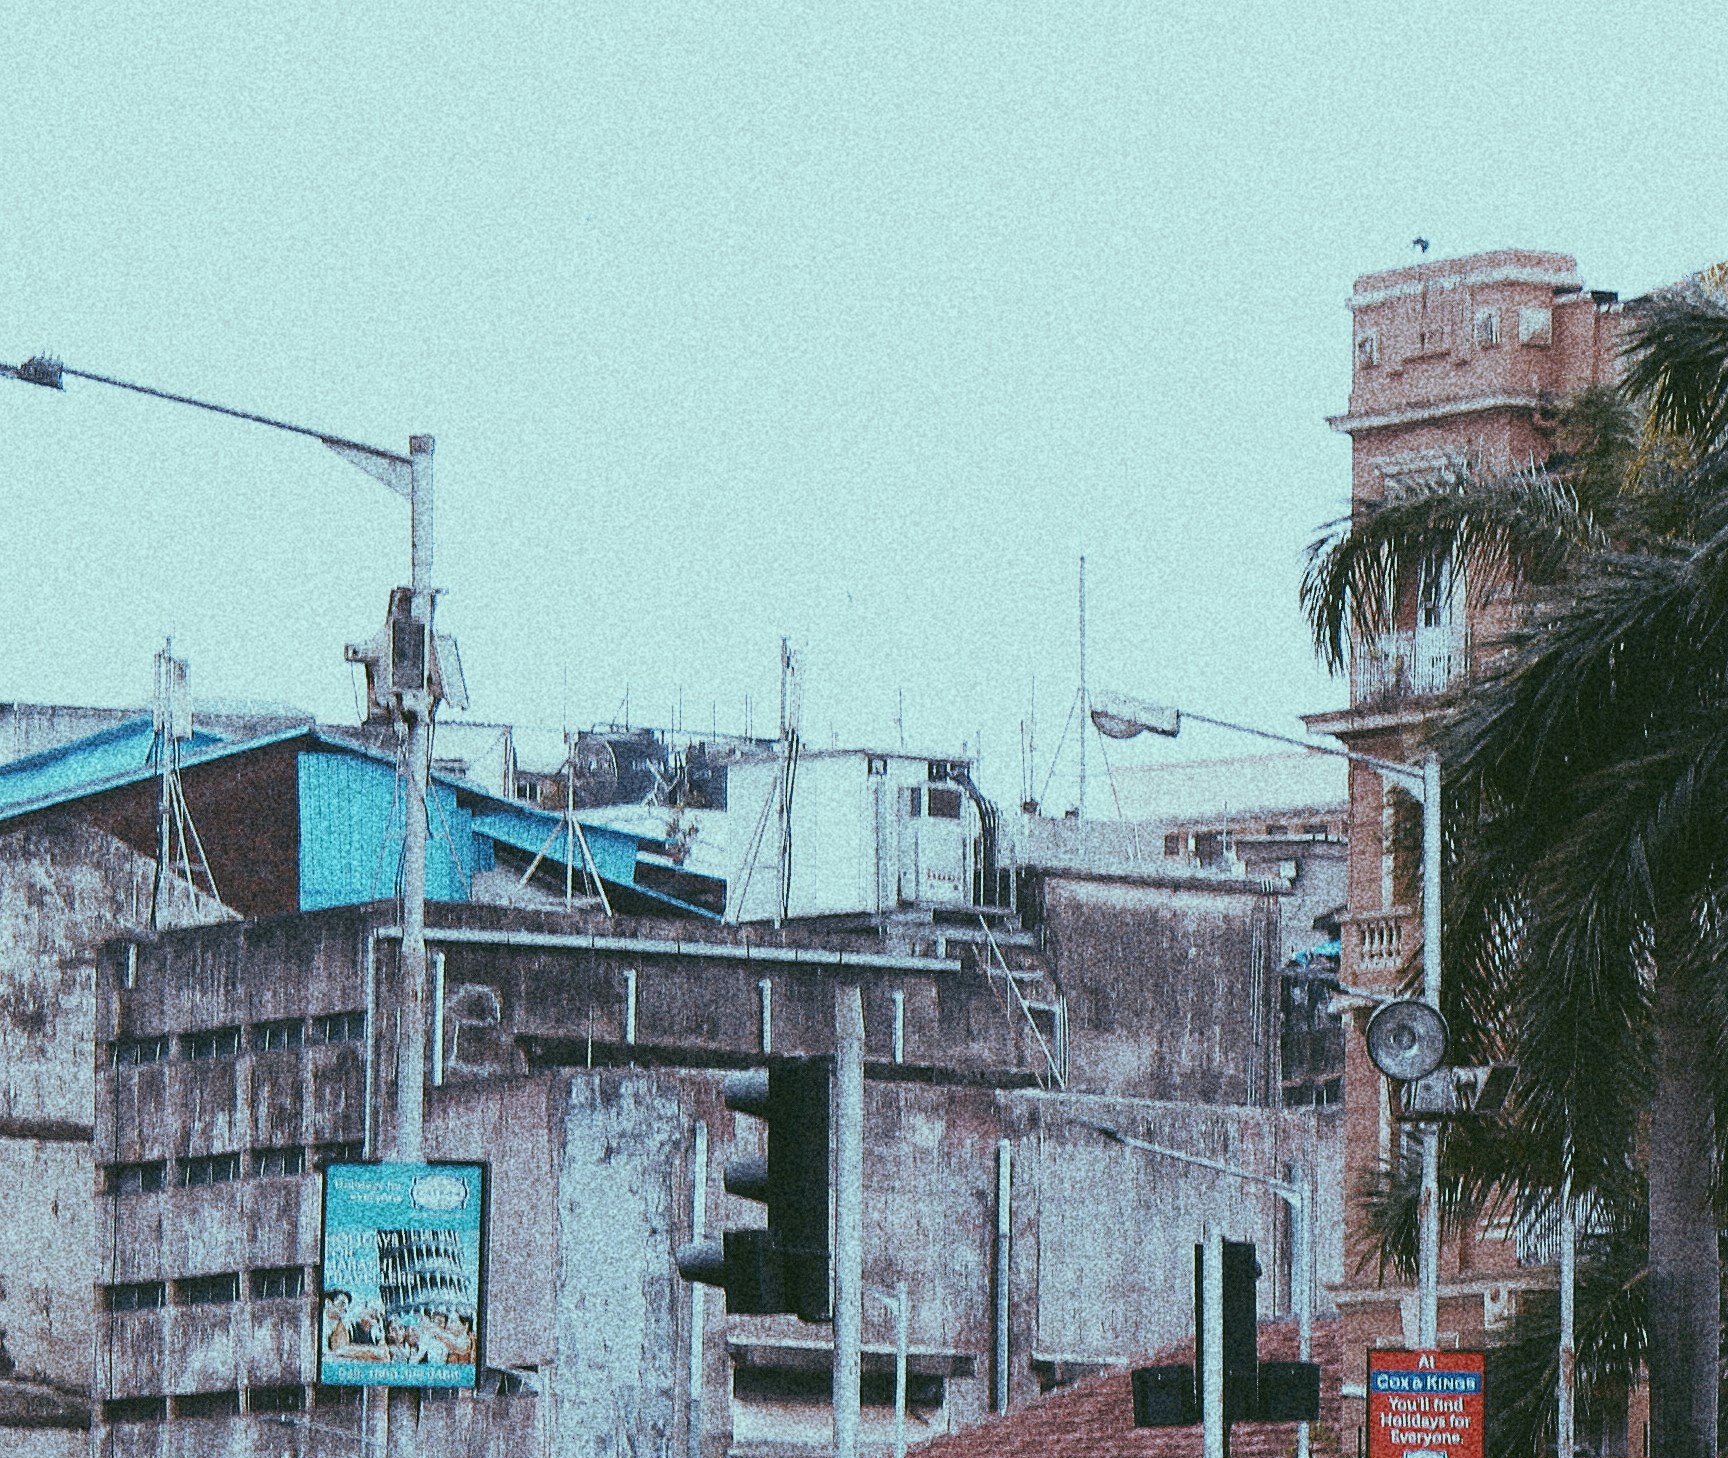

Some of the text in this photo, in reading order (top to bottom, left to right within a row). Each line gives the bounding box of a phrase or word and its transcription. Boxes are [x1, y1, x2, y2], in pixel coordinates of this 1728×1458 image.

[1433, 1398, 1464, 1413] find
[1380, 1412, 1472, 1429] Holidays for
